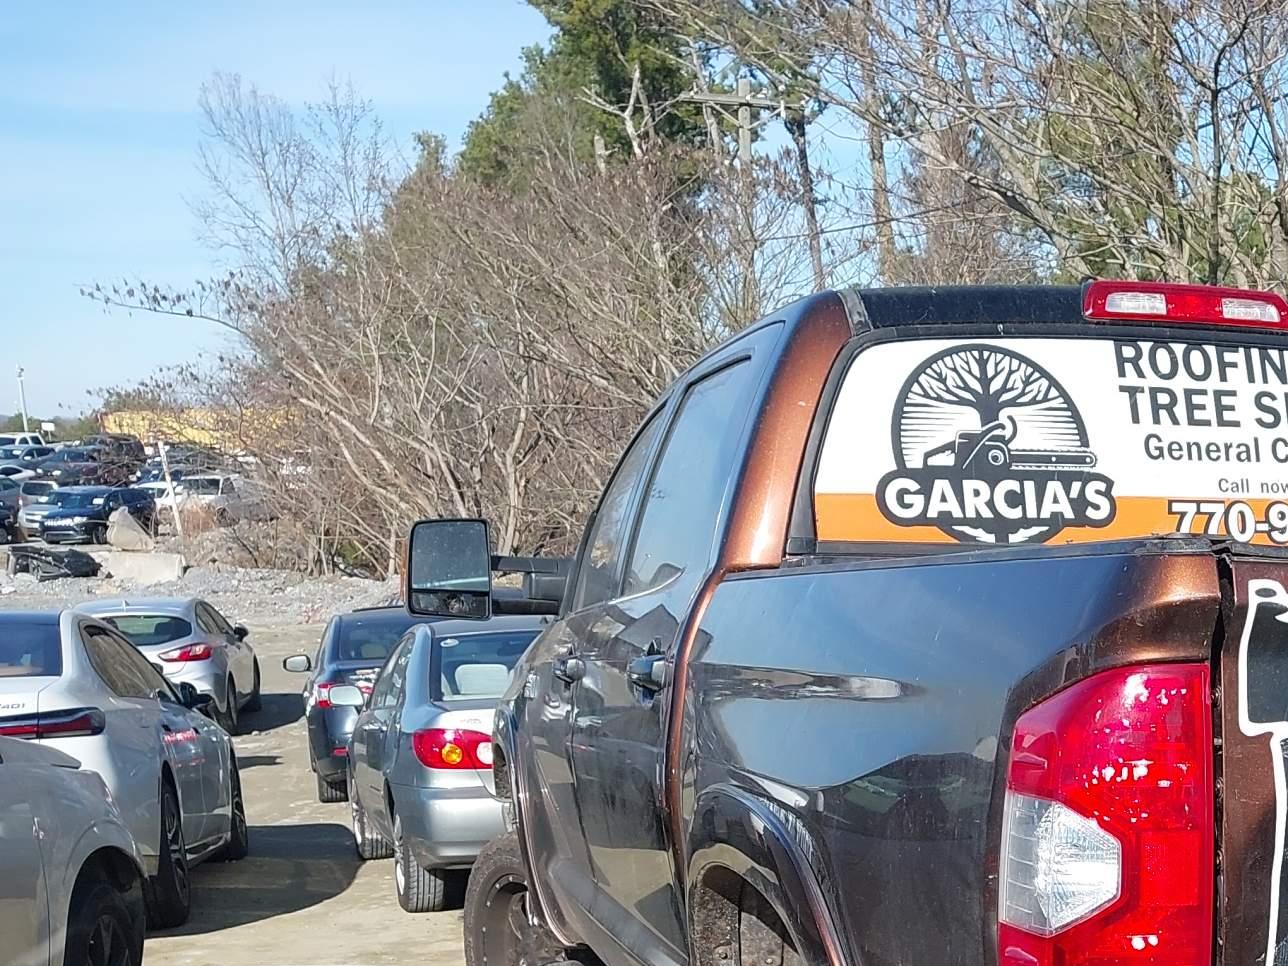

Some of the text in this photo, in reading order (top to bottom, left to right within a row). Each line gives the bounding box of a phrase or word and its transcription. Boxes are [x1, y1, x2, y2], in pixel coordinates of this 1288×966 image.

[1119, 385, 1241, 427] TREE
[1144, 433, 1261, 463] General
[884, 477, 1111, 520] GARCIA'S
[1218, 478, 1250, 493] Call
